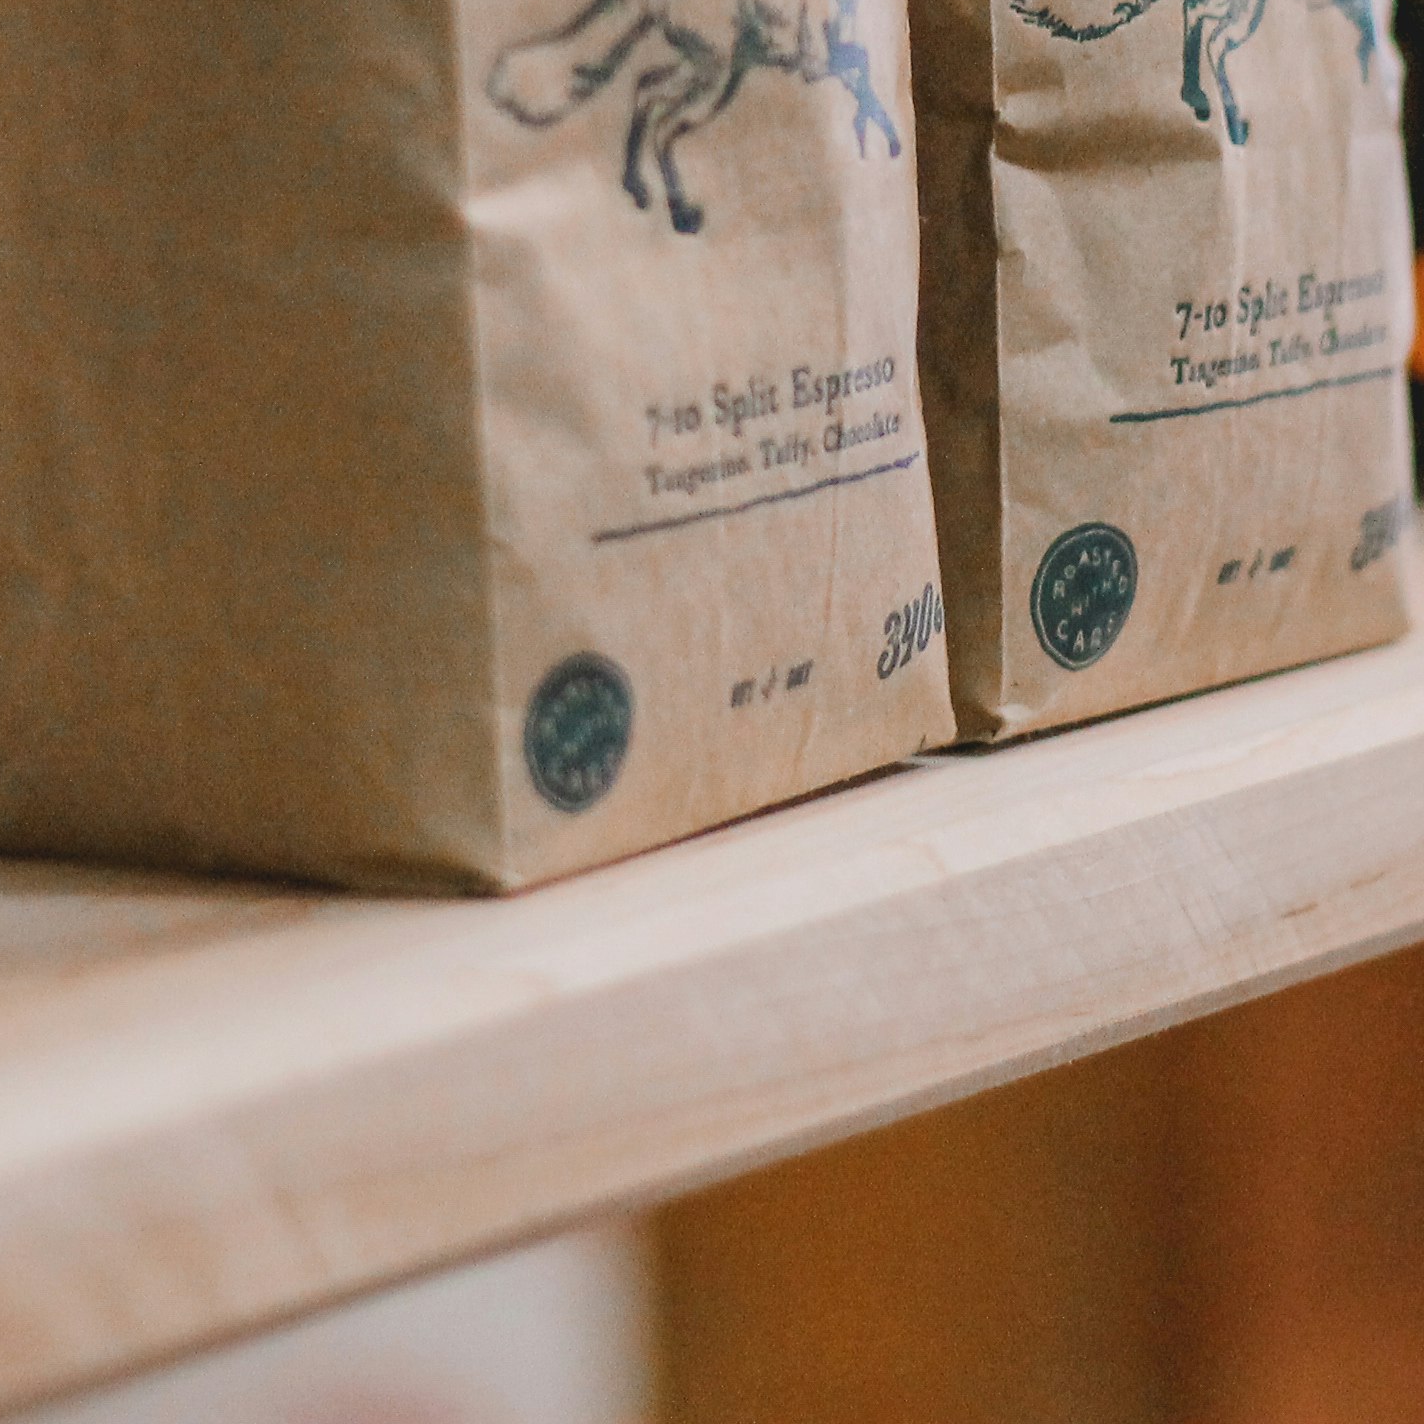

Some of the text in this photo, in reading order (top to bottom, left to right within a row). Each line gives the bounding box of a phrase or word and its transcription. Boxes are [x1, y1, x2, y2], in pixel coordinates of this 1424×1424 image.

[1174, 298, 1229, 340] 7-10
[1236, 276, 1289, 336] Split
[643, 355, 897, 447] 7-10 Split Espresso
